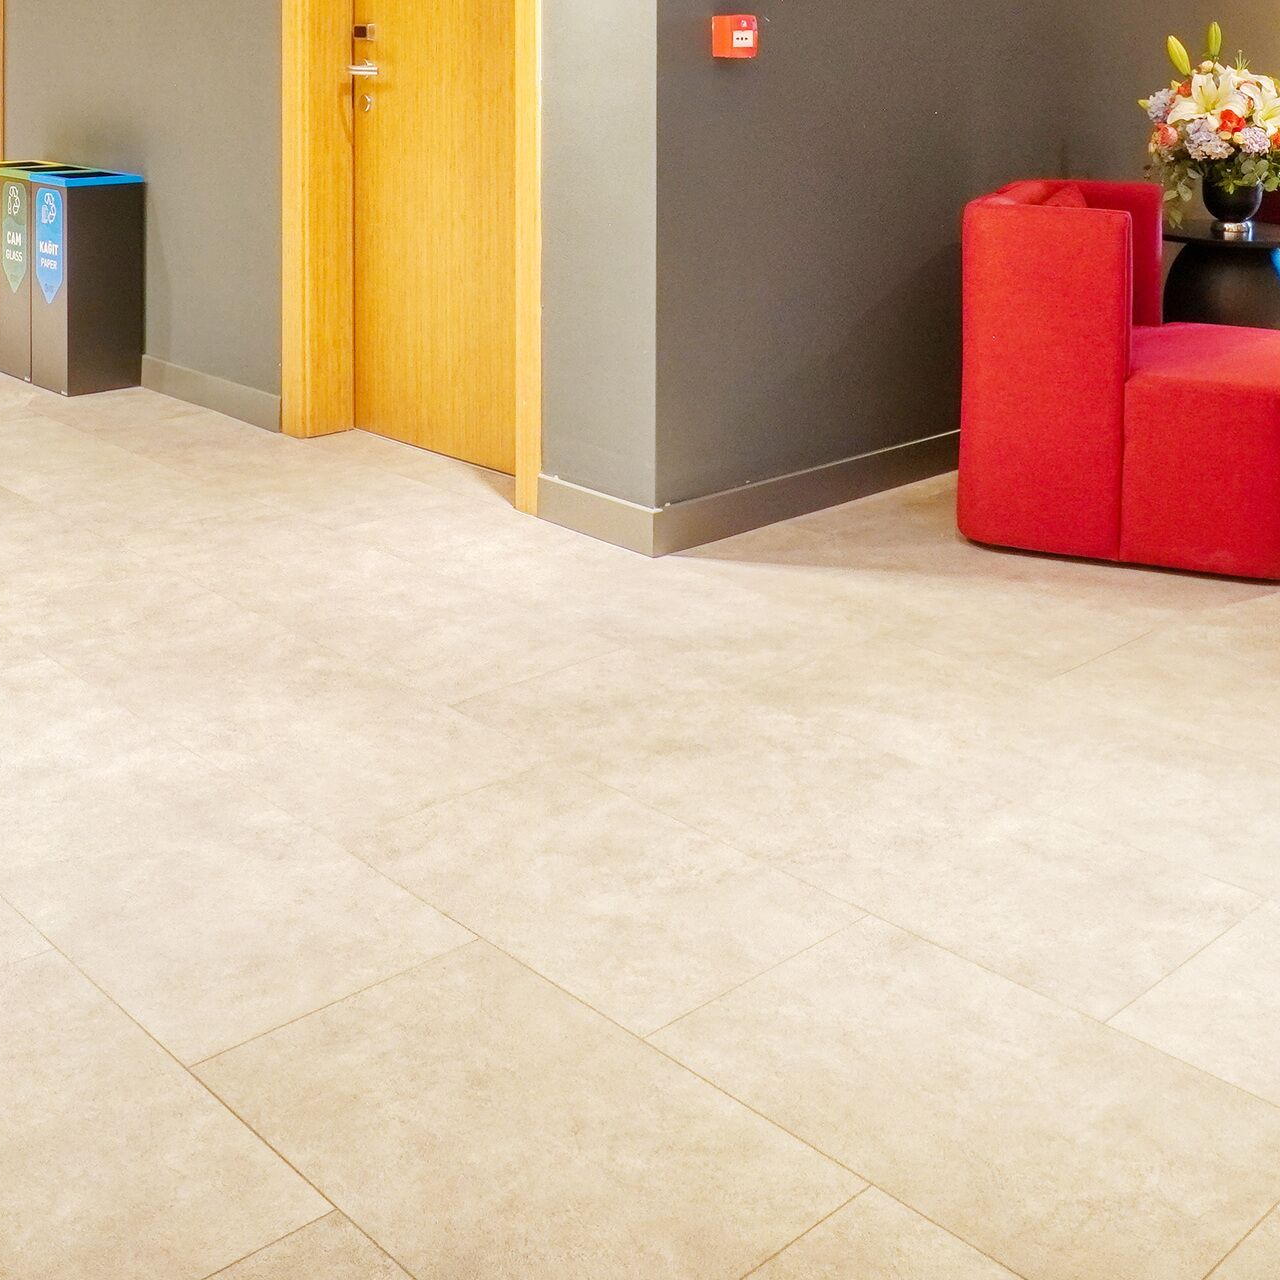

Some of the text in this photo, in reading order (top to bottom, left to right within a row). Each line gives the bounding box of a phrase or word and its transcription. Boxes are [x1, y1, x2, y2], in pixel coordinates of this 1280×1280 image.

[6, 231, 22, 246] CAM
[5, 249, 23, 262] GLASS
[40, 257, 58, 270] PAPER
